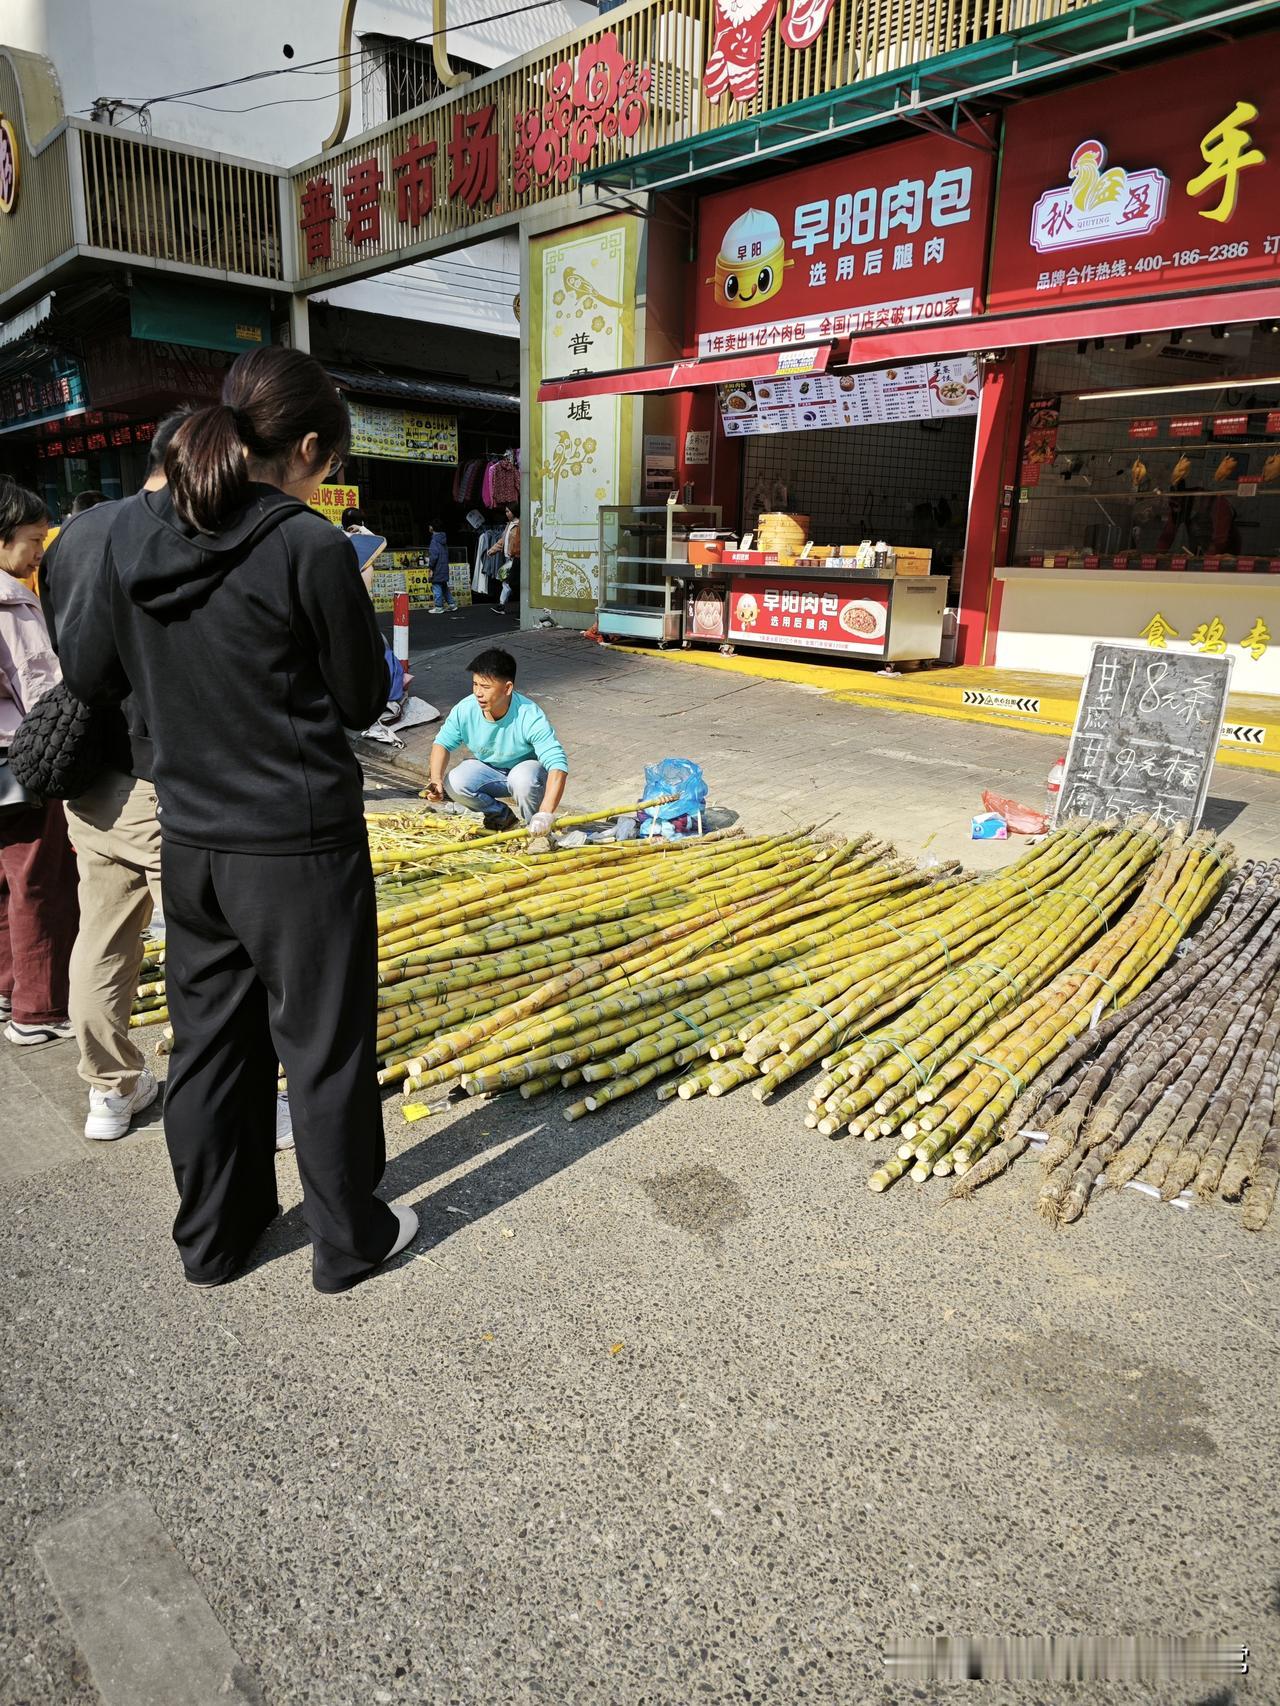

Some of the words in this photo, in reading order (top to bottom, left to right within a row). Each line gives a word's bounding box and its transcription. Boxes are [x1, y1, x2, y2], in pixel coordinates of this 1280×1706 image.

[300, 103, 499, 264] 普君市场
[1186, 101, 1266, 223] 手
[791, 166, 973, 256] 早阳肉包
[1041, 200, 1074, 238] 秋
[1115, 183, 1151, 225] 盈
[1076, 215, 1110, 230] QIUYING
[737, 241, 762, 261] 早阳
[808, 236, 945, 288] 选用后腿肉
[706, 322, 806, 354] 1年卖出1亿个肉包
[819, 296, 960, 338] 全国门店突破1700家
[310, 488, 356, 507] 回收黄金
[762, 589, 839, 616] 早阳肉包
[770, 616, 828, 632] 选用后腿肉
